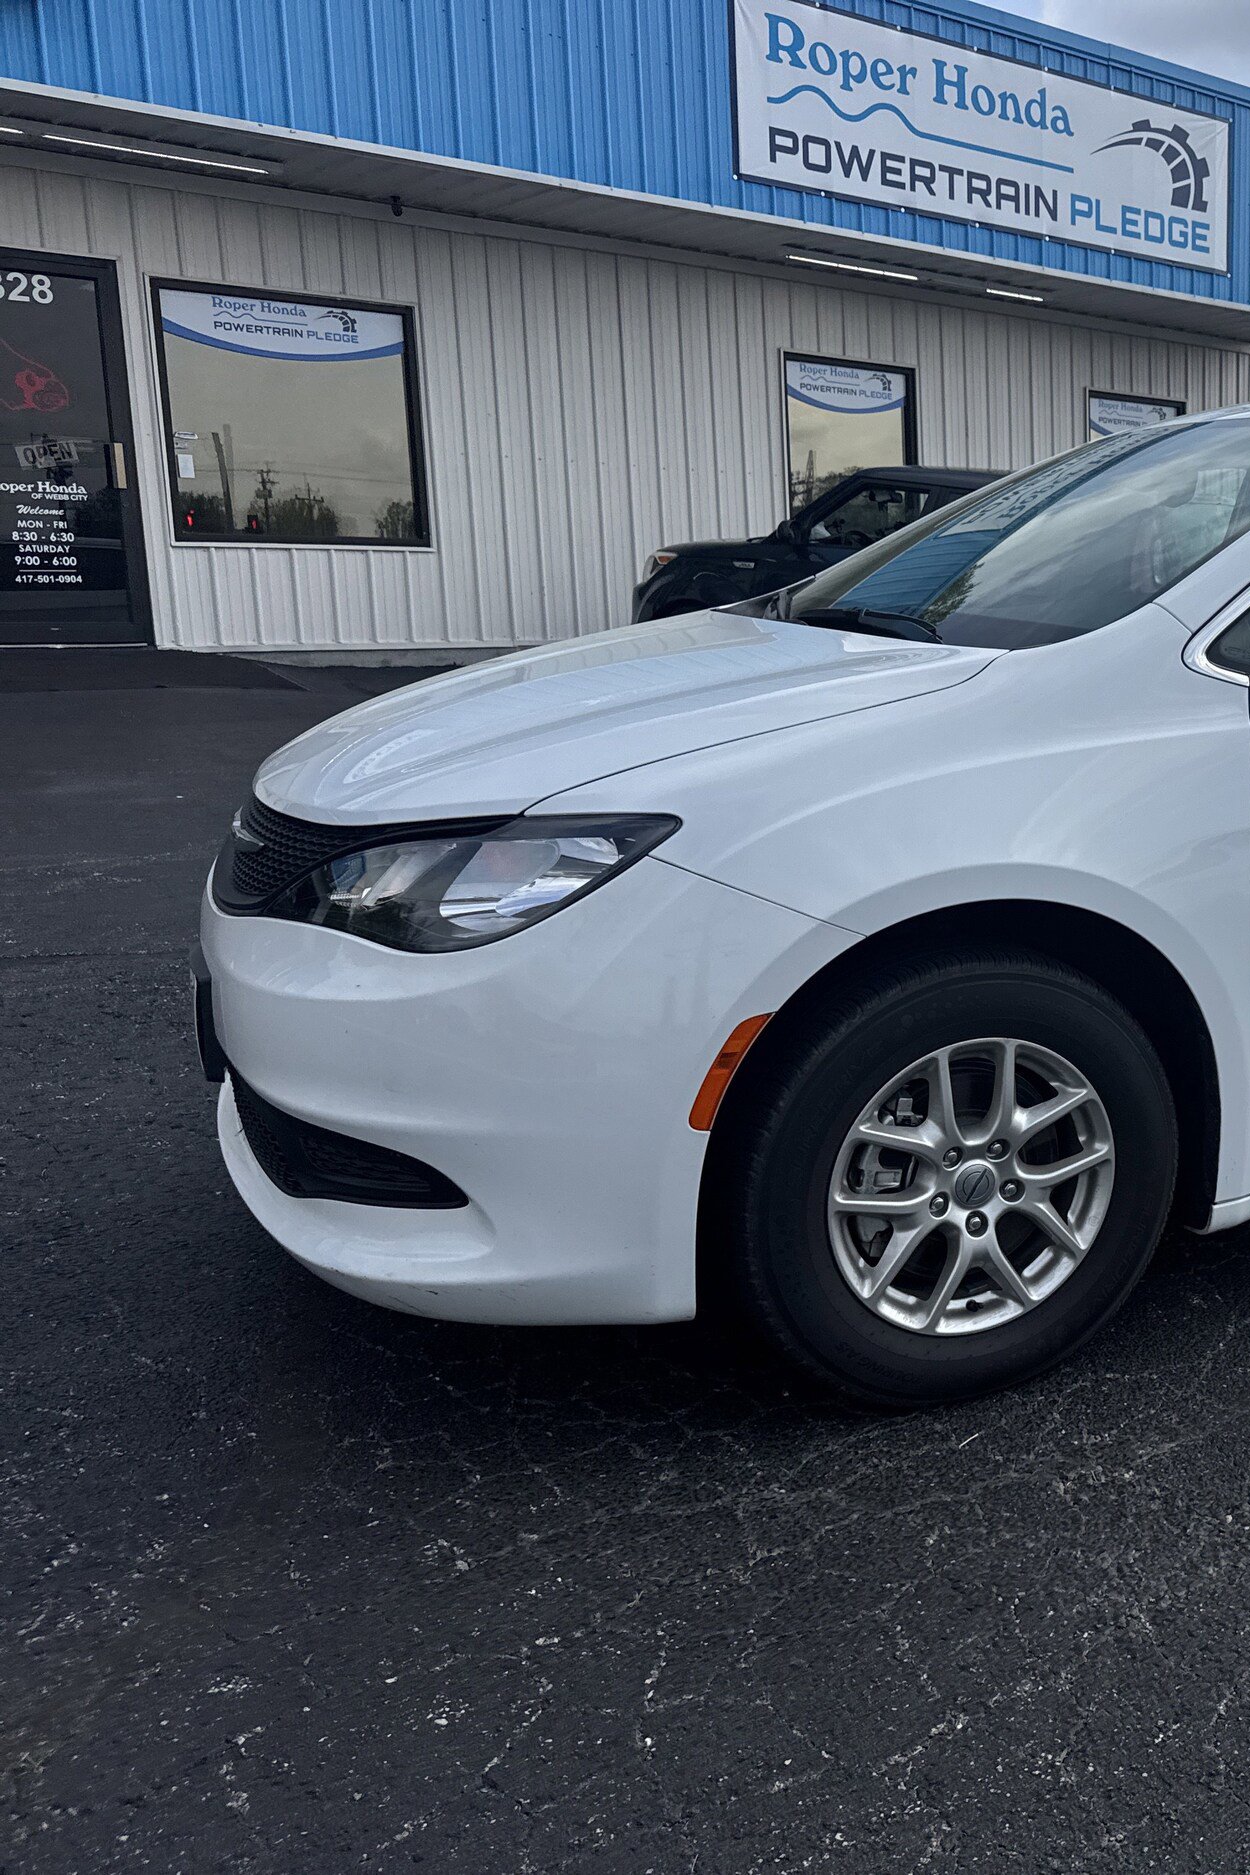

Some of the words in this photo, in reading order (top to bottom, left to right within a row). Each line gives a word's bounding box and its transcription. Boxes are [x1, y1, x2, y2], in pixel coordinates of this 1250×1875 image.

[765, 12, 918, 96] Roper
[932, 58, 1075, 138] Honda
[768, 126, 1059, 222] POWERTRAIN
[1070, 193, 1211, 254] PLEDGE
[211, 296, 257, 313] Roper
[260, 301, 308, 318] Honda
[213, 320, 304, 339] POWERTRAIN
[306, 330, 360, 345] PLEDGE
[799, 363, 828, 376] Roper
[829, 367, 860, 379] Honda
[800, 382, 858, 396] POWERTRAIN
[858, 389, 893, 400] PLEDGE
[23, 442, 73, 466] OPEN
[0, 483, 34, 494] oper
[37, 481, 87, 494] Honda
[44, 493, 69, 501] WEBB
[16, 504, 65, 516] Welcome
[17, 520, 43, 528] MON
[53, 521, 67, 529] FRI
[12, 531, 38, 541] 8:30
[50, 532, 75, 542] 6:30
[18, 544, 70, 553] SATURDAY
[14, 556, 41, 566] 9:00
[52, 556, 77, 566] 6:00
[15, 575, 83, 583] 417-501-0904
